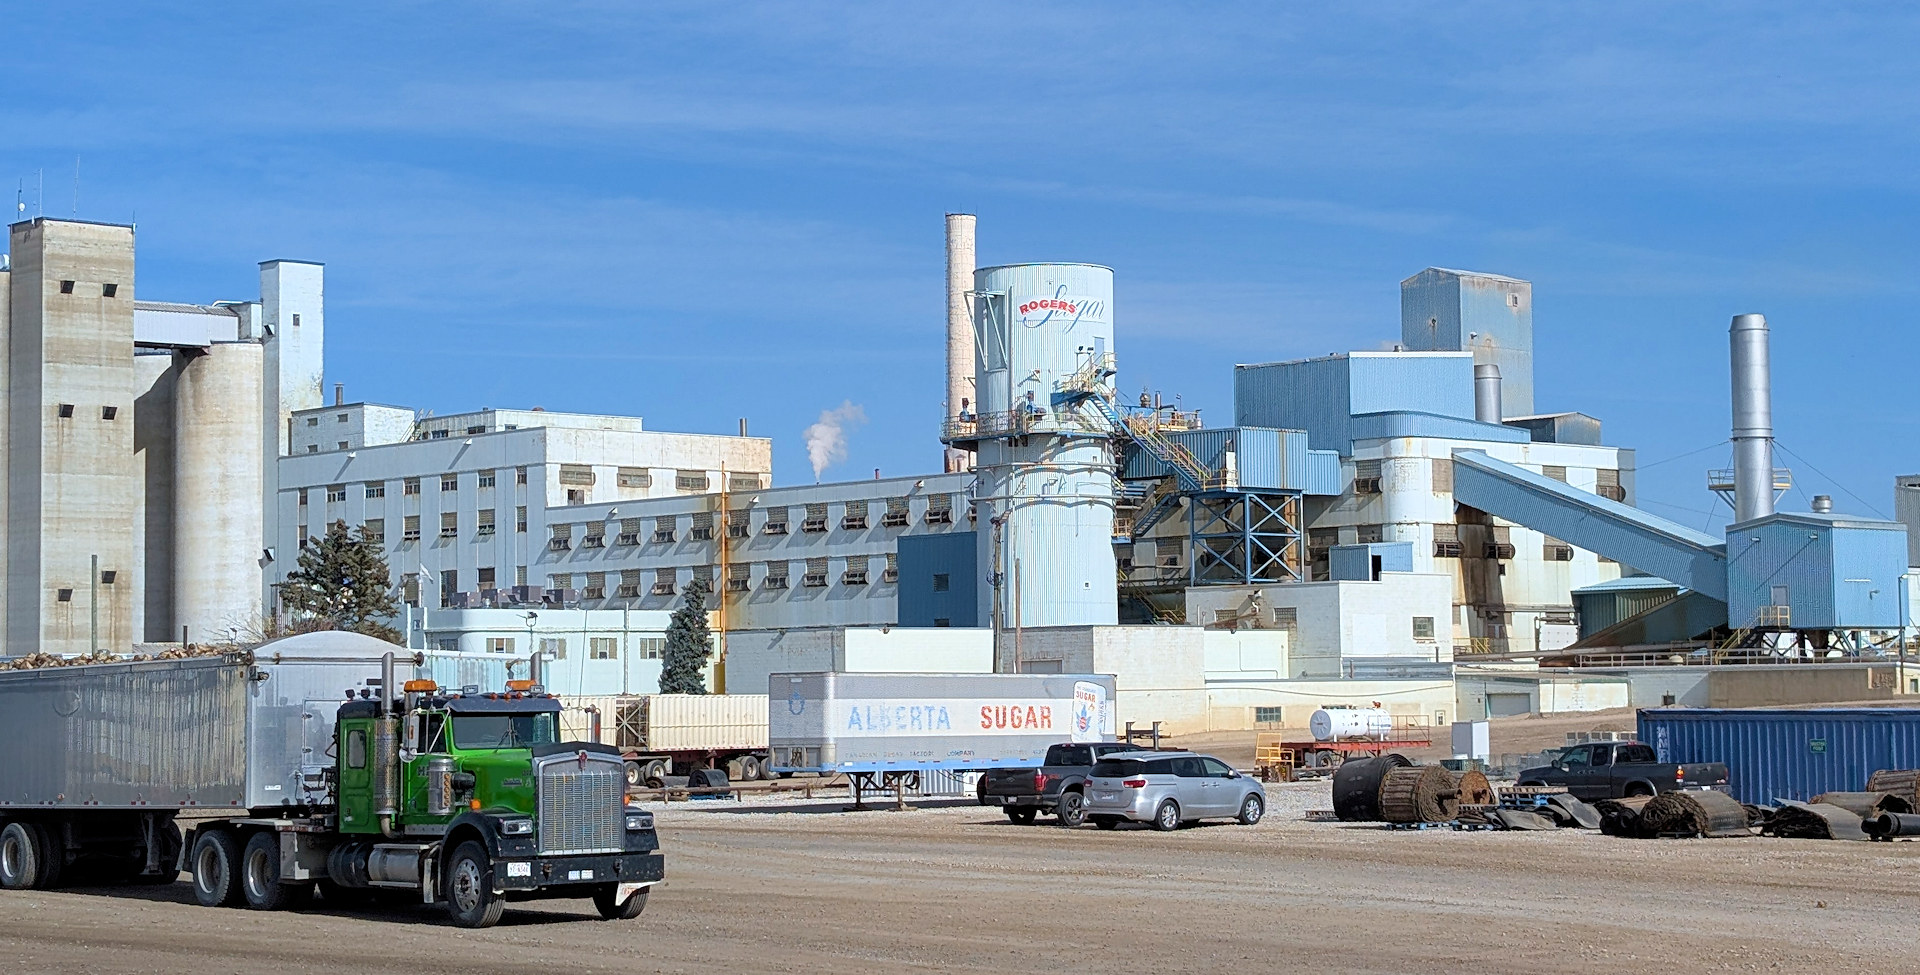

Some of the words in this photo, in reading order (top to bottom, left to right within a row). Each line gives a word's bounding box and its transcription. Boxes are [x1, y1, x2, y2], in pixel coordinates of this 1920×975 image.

[1019, 299, 1077, 315] ROGERS
[1076, 690, 1096, 703] SUGAR
[847, 705, 952, 731] ALBERTA
[981, 705, 1052, 729] SUGAR
